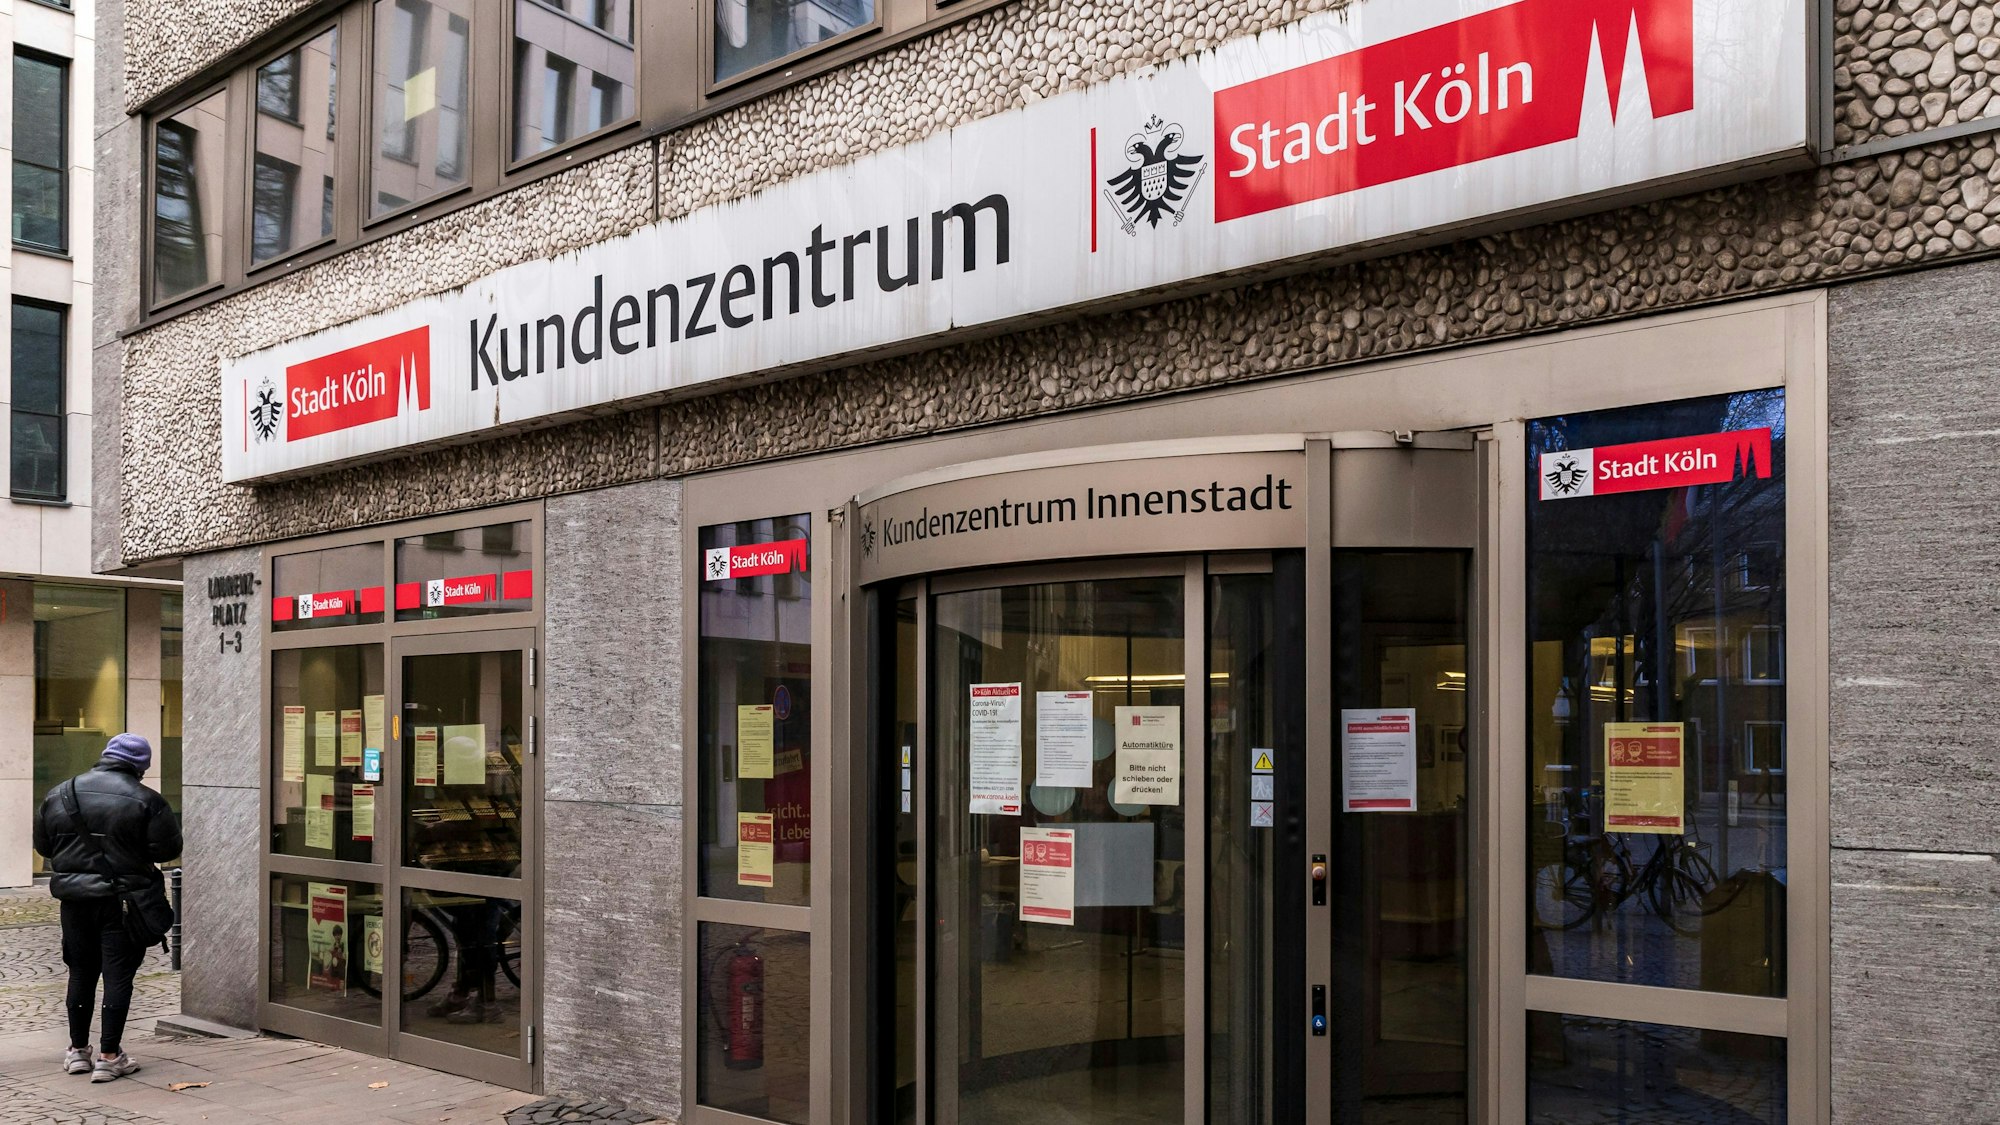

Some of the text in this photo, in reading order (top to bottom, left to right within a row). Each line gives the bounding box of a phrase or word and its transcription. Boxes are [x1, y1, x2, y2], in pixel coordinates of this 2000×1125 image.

[1228, 51, 1533, 178] Stadt Köln
[470, 193, 1010, 391] Kundenzentrum
[291, 364, 386, 418] Stadt Köln
[1598, 448, 1717, 480] Stadt Köln
[883, 474, 1293, 547] Kundenzentrum Innenstadt
[731, 550, 784, 569] Stadt Köln
[445, 584, 481, 598] Stadt Köln
[213, 602, 247, 627] PLATZ
[313, 597, 343, 611] Stadt Köln
[1122, 741, 1174, 749] Automatiktüre
[1129, 764, 1146, 772] Bitte
